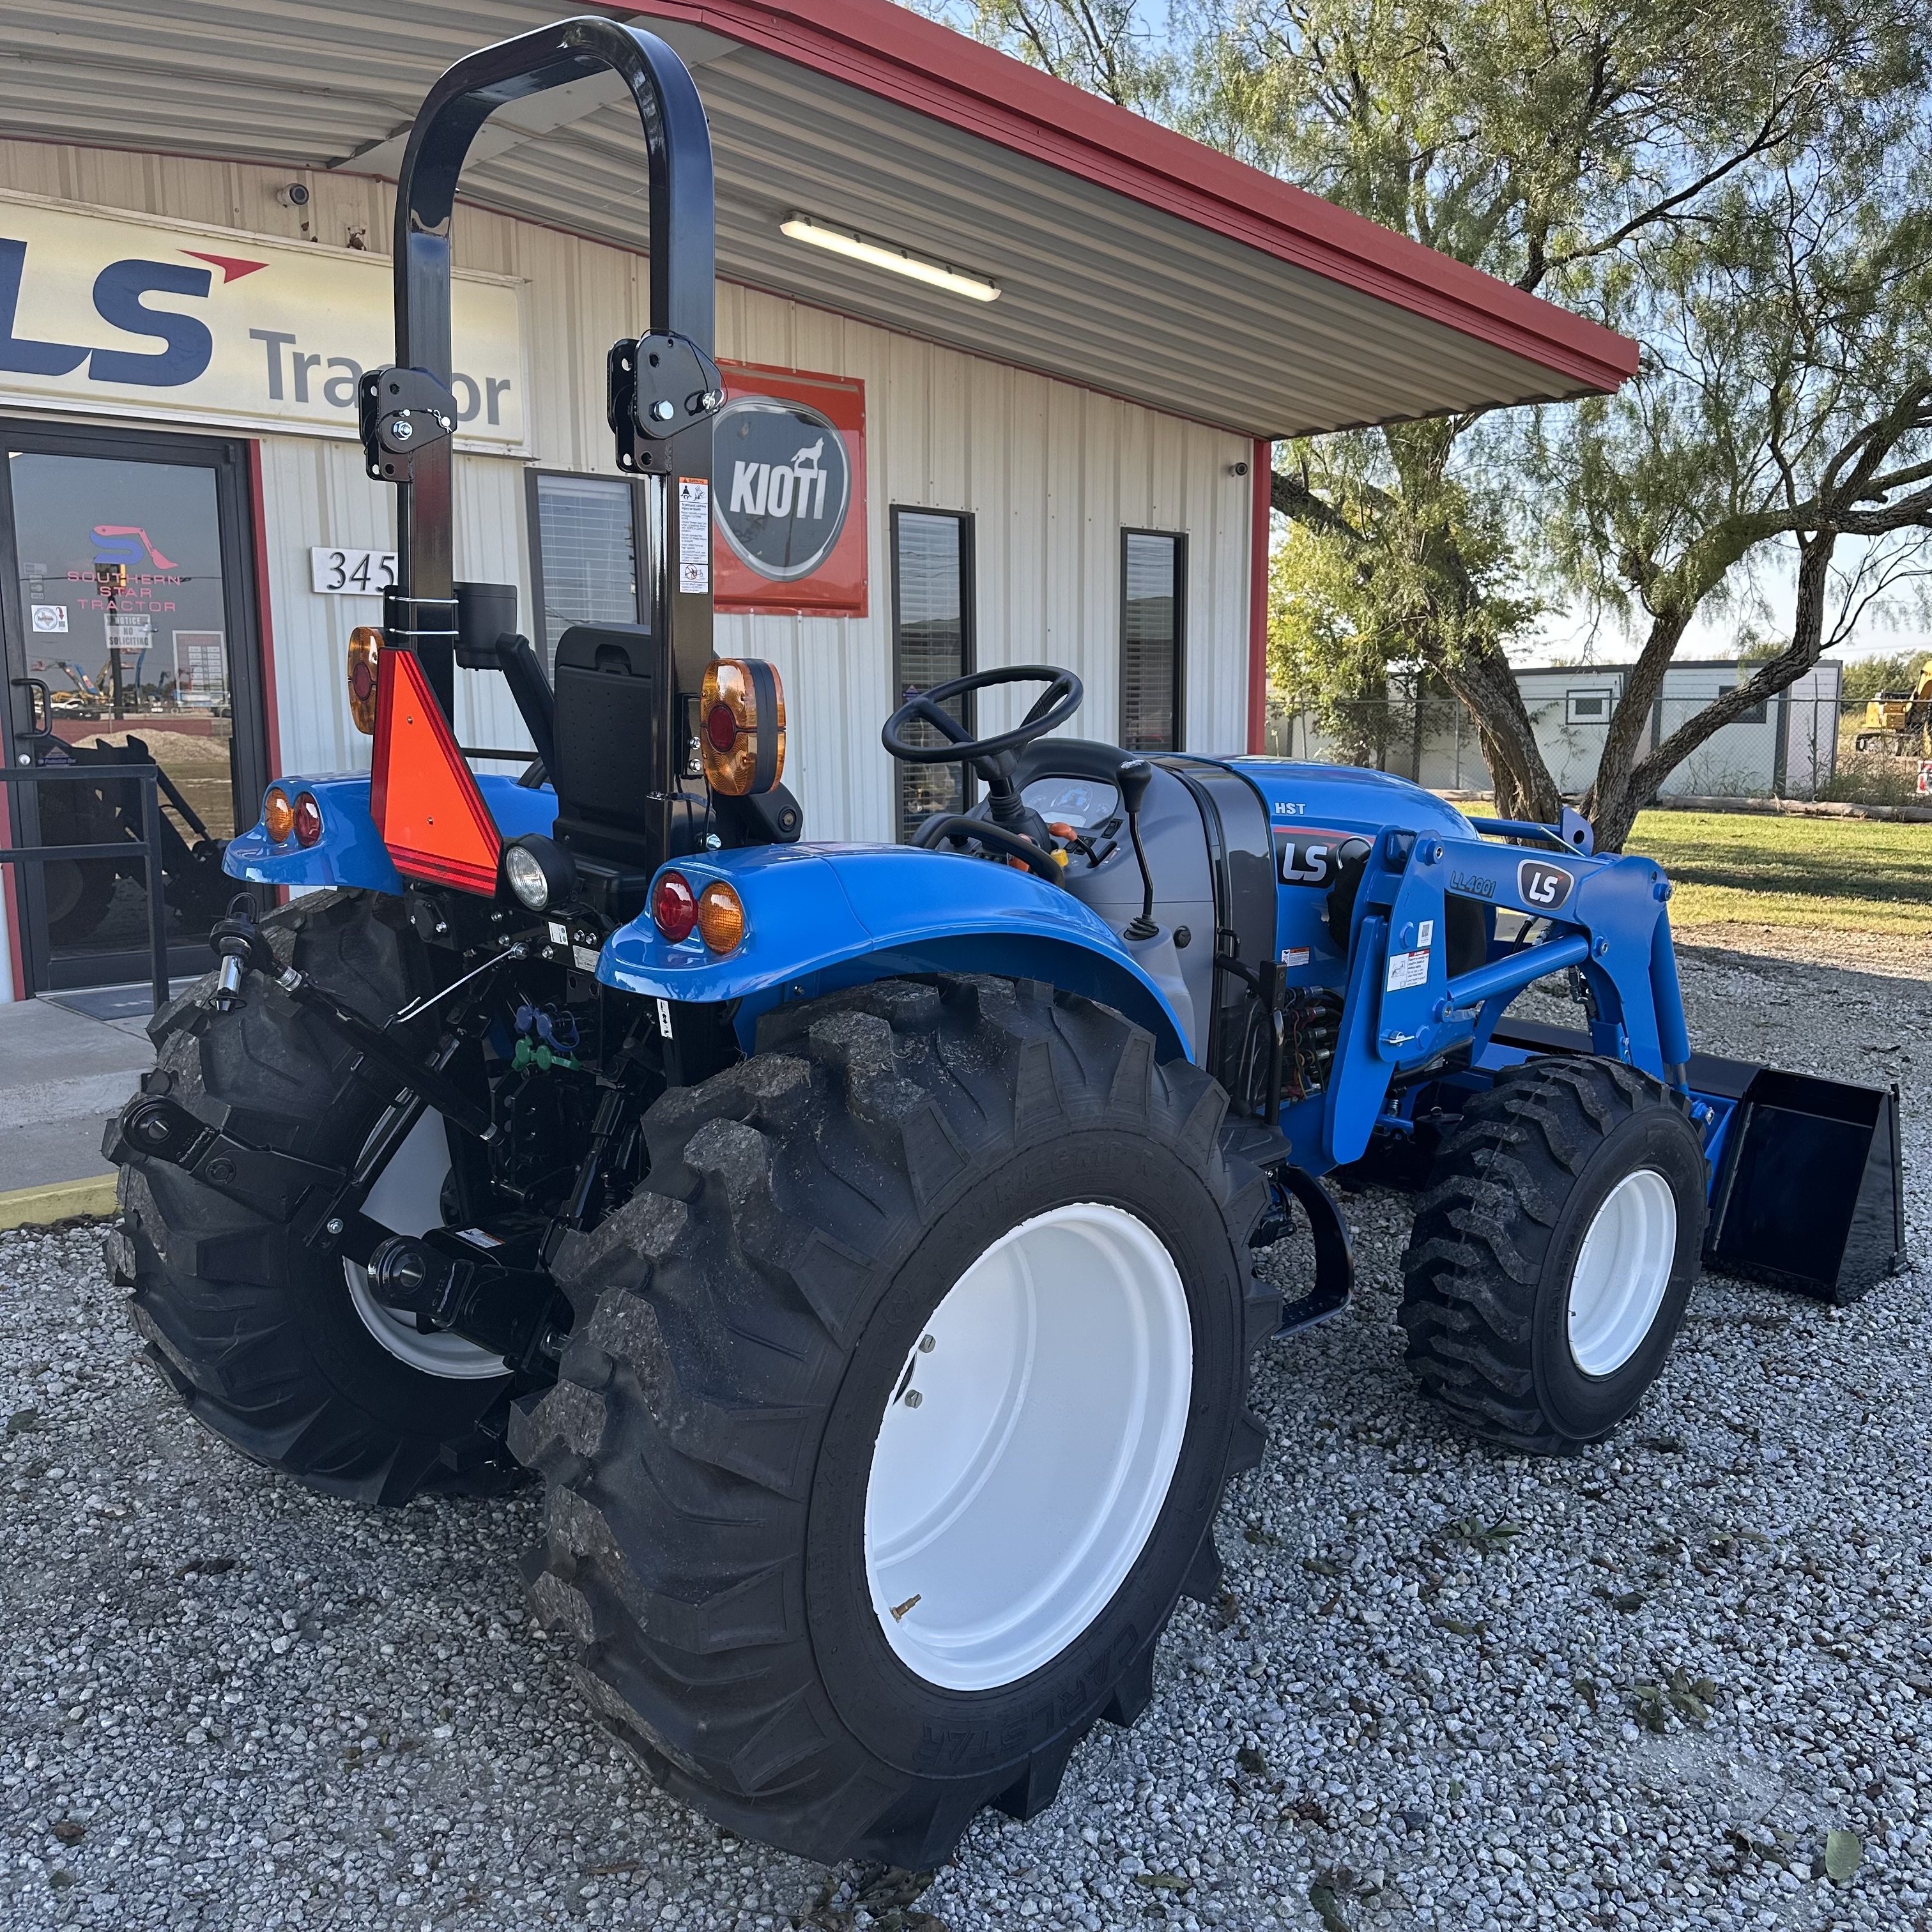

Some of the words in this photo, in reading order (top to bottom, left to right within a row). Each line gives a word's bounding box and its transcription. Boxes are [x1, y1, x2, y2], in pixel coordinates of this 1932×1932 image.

[0, 238, 213, 387] LS
[249, 328, 510, 425] Traor
[730, 461, 827, 519] KIOTI
[67, 571, 181, 586] SOUTHERN
[327, 552, 395, 592] 345
[100, 586, 152, 599] STAR
[77, 599, 176, 613] TRACTOR
[115, 617, 141, 625] NOTICE
[123, 627, 134, 636] NO
[109, 637, 149, 646] SOLICITING
[1275, 802, 1306, 815] HST
[1283, 843, 1328, 881] LS
[1450, 871, 1497, 898] LL4001
[1529, 872, 1558, 903] LS
